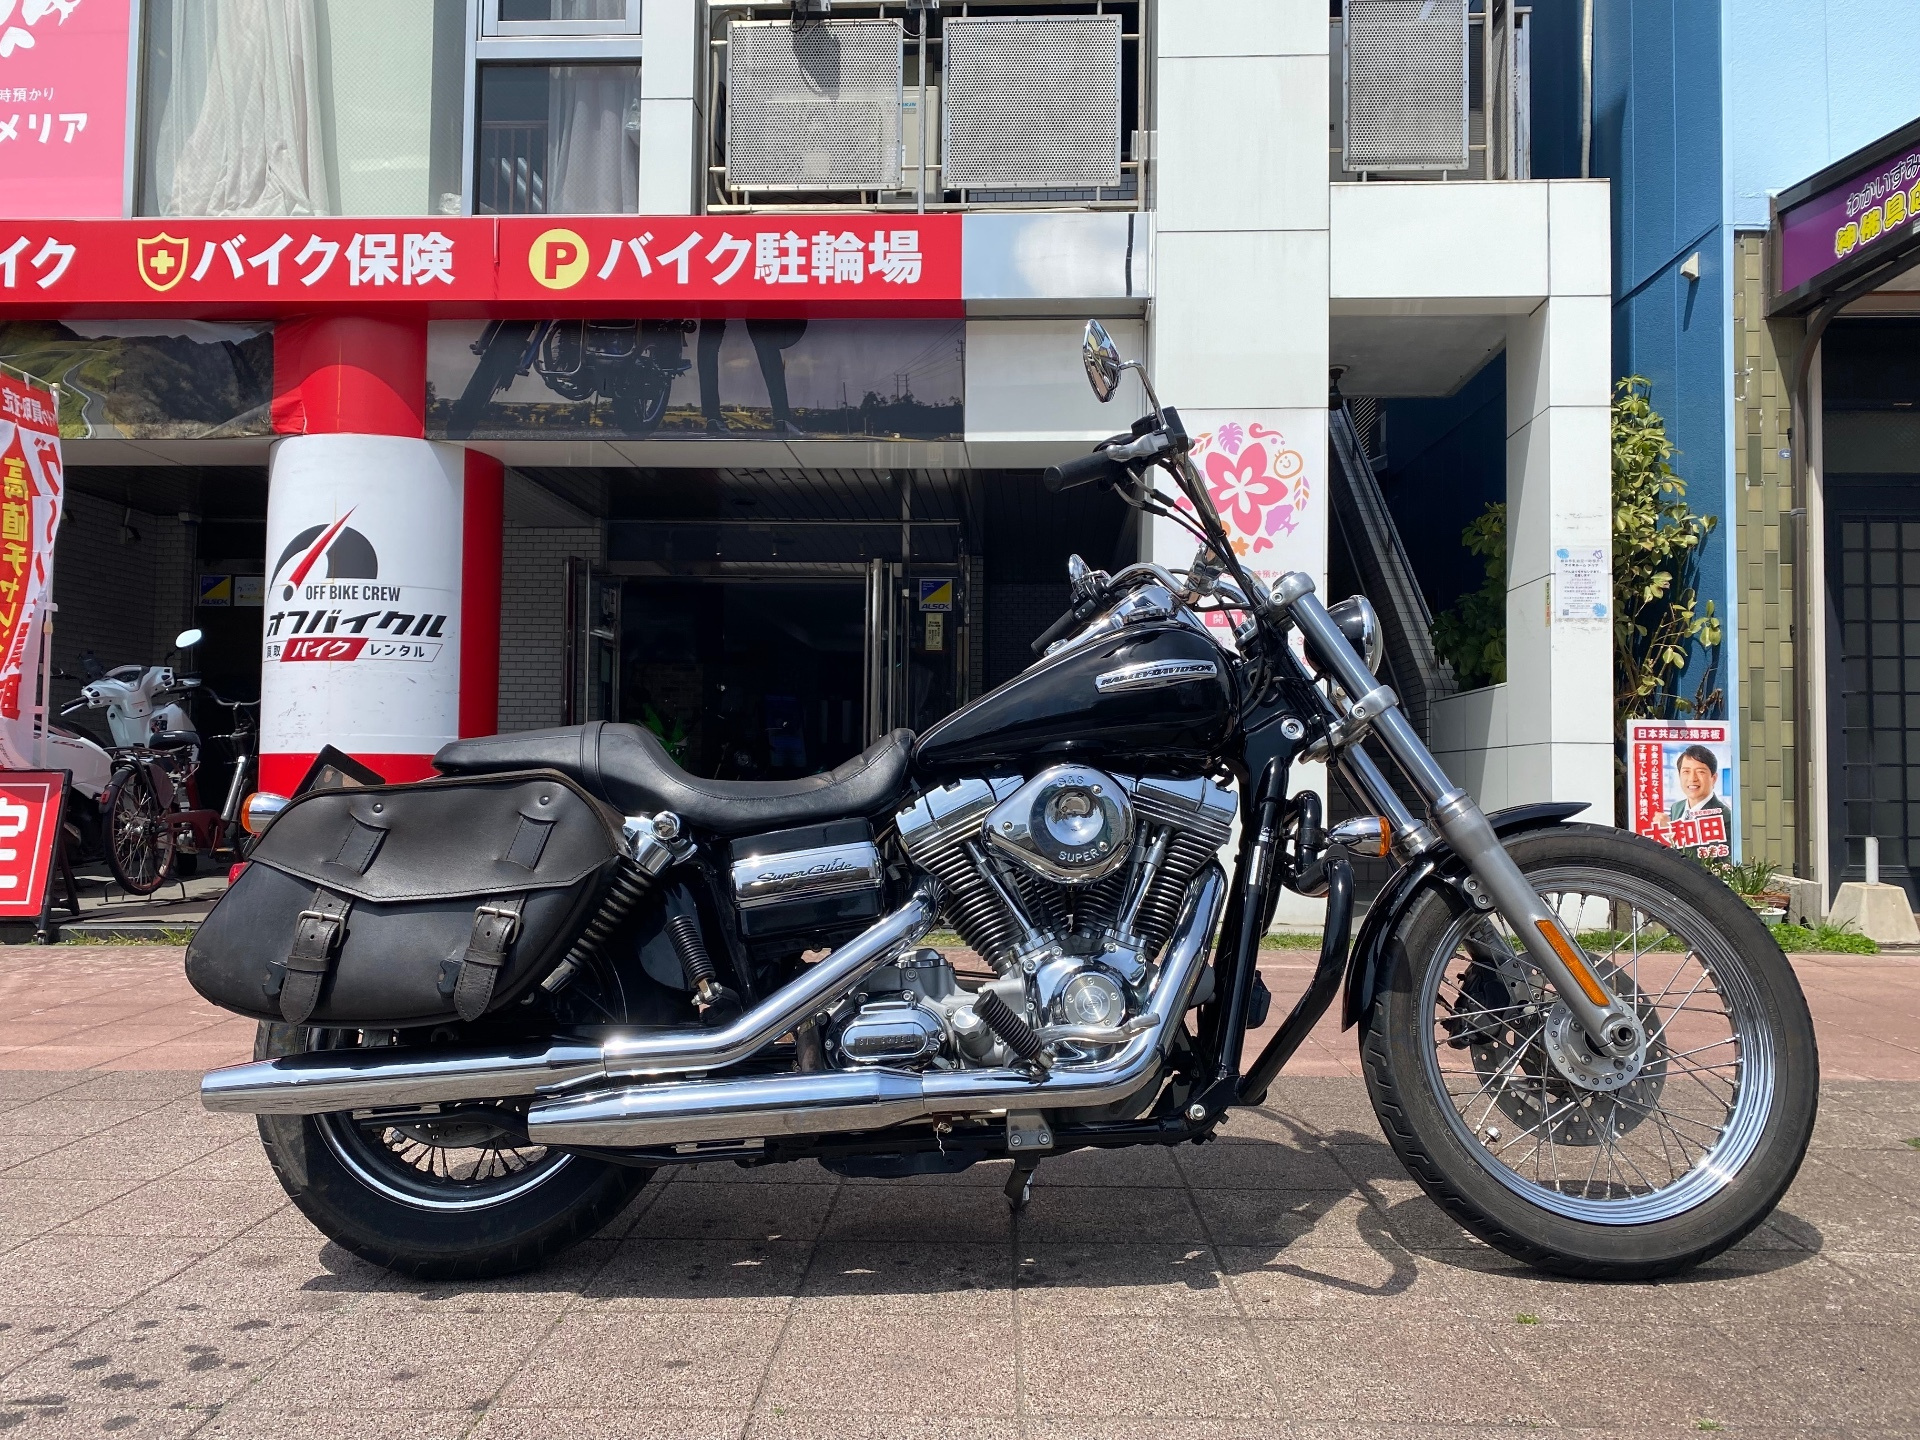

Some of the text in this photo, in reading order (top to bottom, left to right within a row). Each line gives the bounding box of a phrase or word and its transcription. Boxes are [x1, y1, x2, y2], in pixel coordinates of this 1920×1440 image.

[190, 231, 456, 287] バイク保険
[544, 230, 923, 286] P バイク駐輪場
[305, 584, 401, 602] OFF BIKE CREW
[266, 609, 448, 638] オフバイクル
[290, 640, 351, 658] バイク
[370, 644, 425, 658] レンタル
[1637, 728, 1721, 740] 日本共産党掲示板
[1057, 775, 1085, 787] S&S
[1638, 744, 1649, 821] 子育てしやすい横浜へ
[1642, 815, 1727, 849] 大和田
[1058, 848, 1100, 863] SUPER
[757, 858, 857, 883] Super Glide
